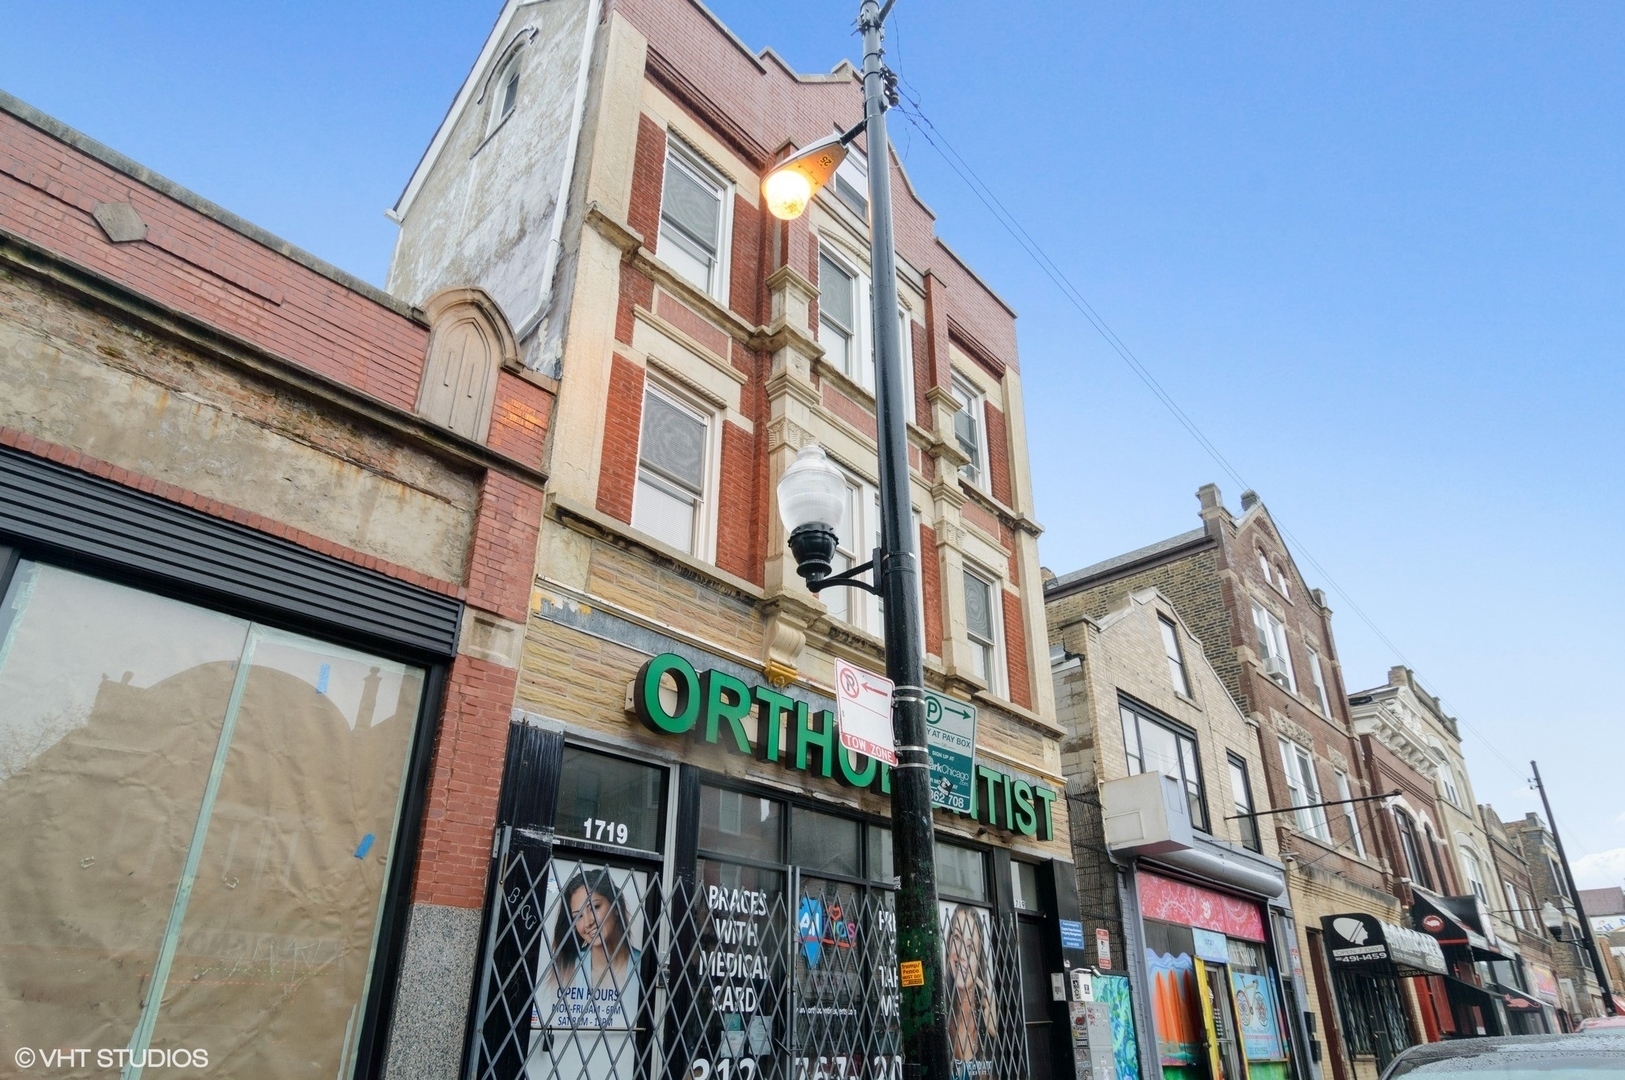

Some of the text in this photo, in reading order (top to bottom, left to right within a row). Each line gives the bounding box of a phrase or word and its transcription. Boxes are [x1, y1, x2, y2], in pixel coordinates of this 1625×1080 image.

[644, 652, 1057, 841] ORTHTIST
[845, 734, 893, 762] TOW ZONE
[932, 730, 941, 738] AT
[942, 733, 956, 744] PAY
[956, 738, 971, 749] BOX
[929, 760, 970, 782] arkChicago
[948, 794, 964, 808] 708
[583, 817, 628, 845] 1719
[709, 885, 767, 916] BRACES
[716, 918, 758, 946] WITH
[1342, 952, 1387, 962] 491-1459
[557, 987, 620, 1002] OPEN HOURS
[712, 985, 757, 1013] CARD
